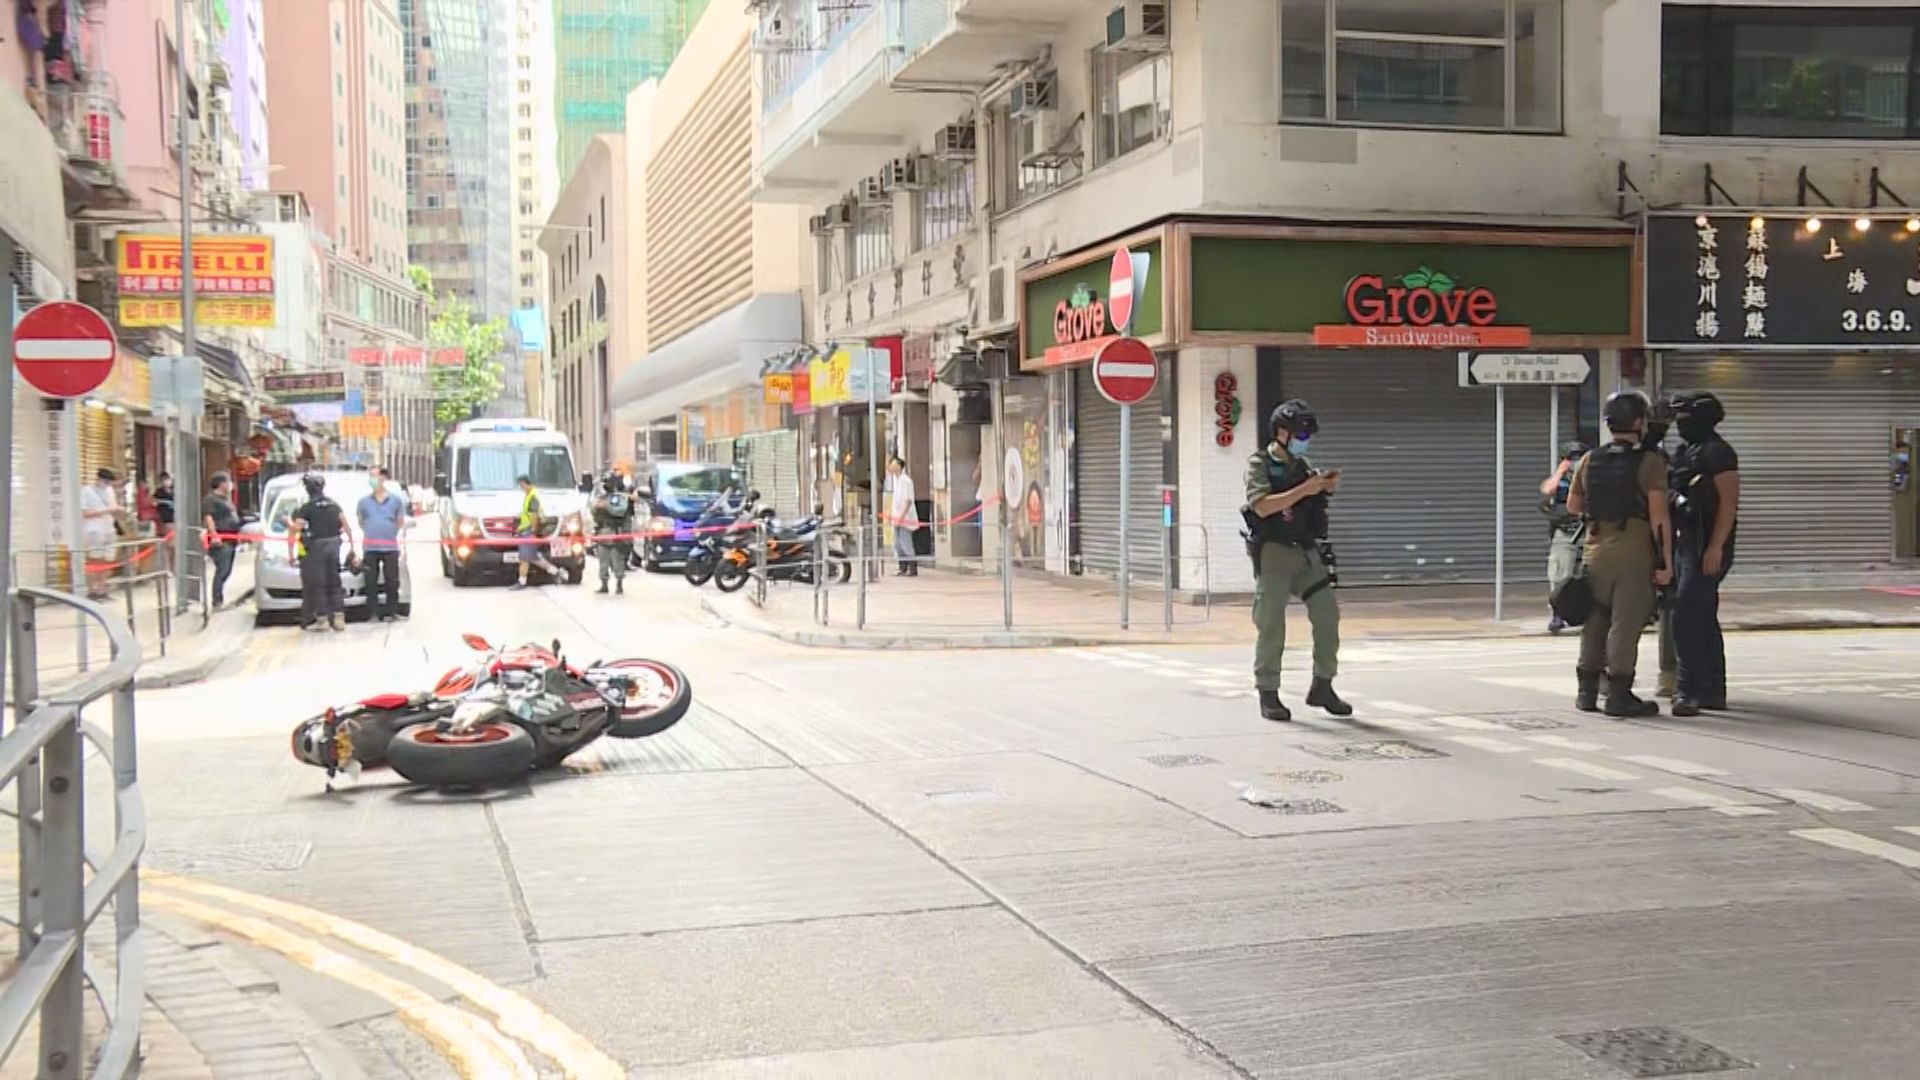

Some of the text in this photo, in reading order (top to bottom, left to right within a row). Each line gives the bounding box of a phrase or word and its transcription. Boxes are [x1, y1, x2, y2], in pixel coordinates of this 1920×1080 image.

[126, 240, 265, 271] PIRELLI
[1346, 275, 1497, 325] Grove
[1054, 301, 1105, 344] Grove
[1365, 327, 1481, 346] Sandwiches
[1842, 309, 1911, 331] 3.6.9.
[1215, 372, 1238, 447] Grove
